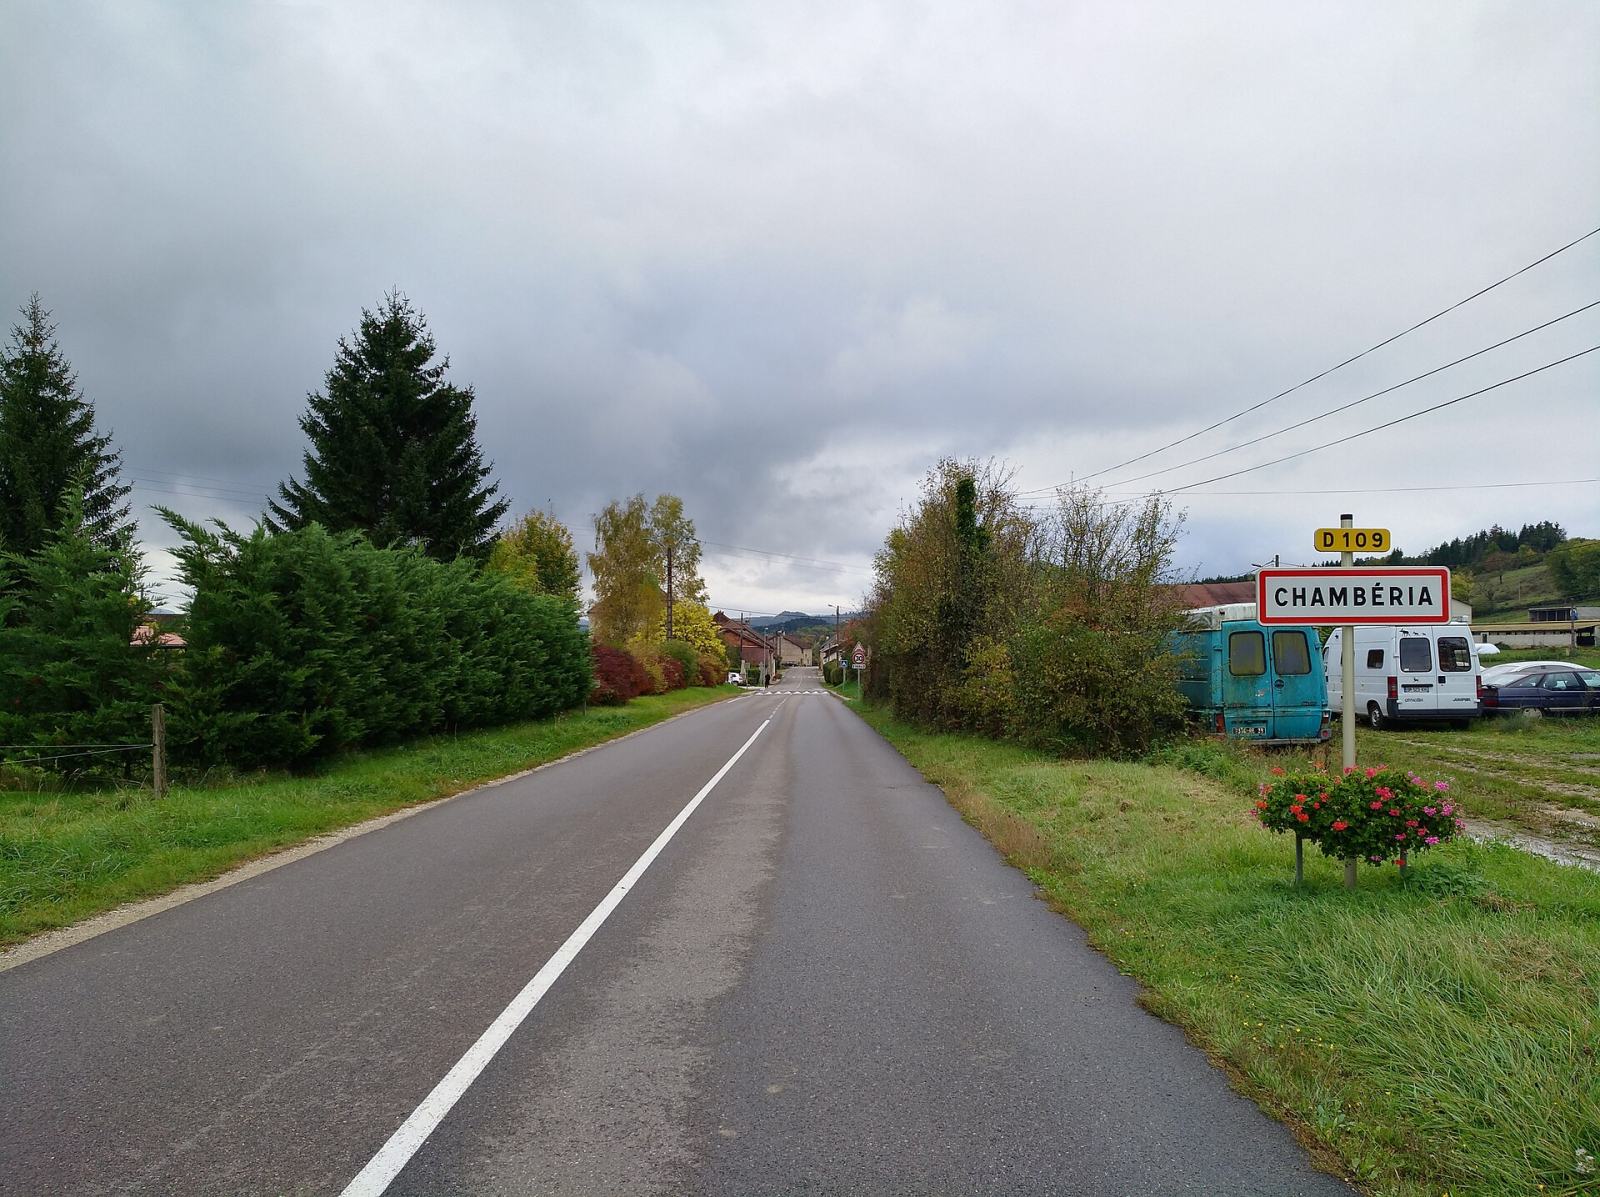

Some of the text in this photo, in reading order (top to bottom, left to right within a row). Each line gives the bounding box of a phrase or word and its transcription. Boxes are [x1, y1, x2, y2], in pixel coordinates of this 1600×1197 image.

[1323, 532, 1383, 548] D 109
[1274, 582, 1433, 607] CHAMBÉRIA
